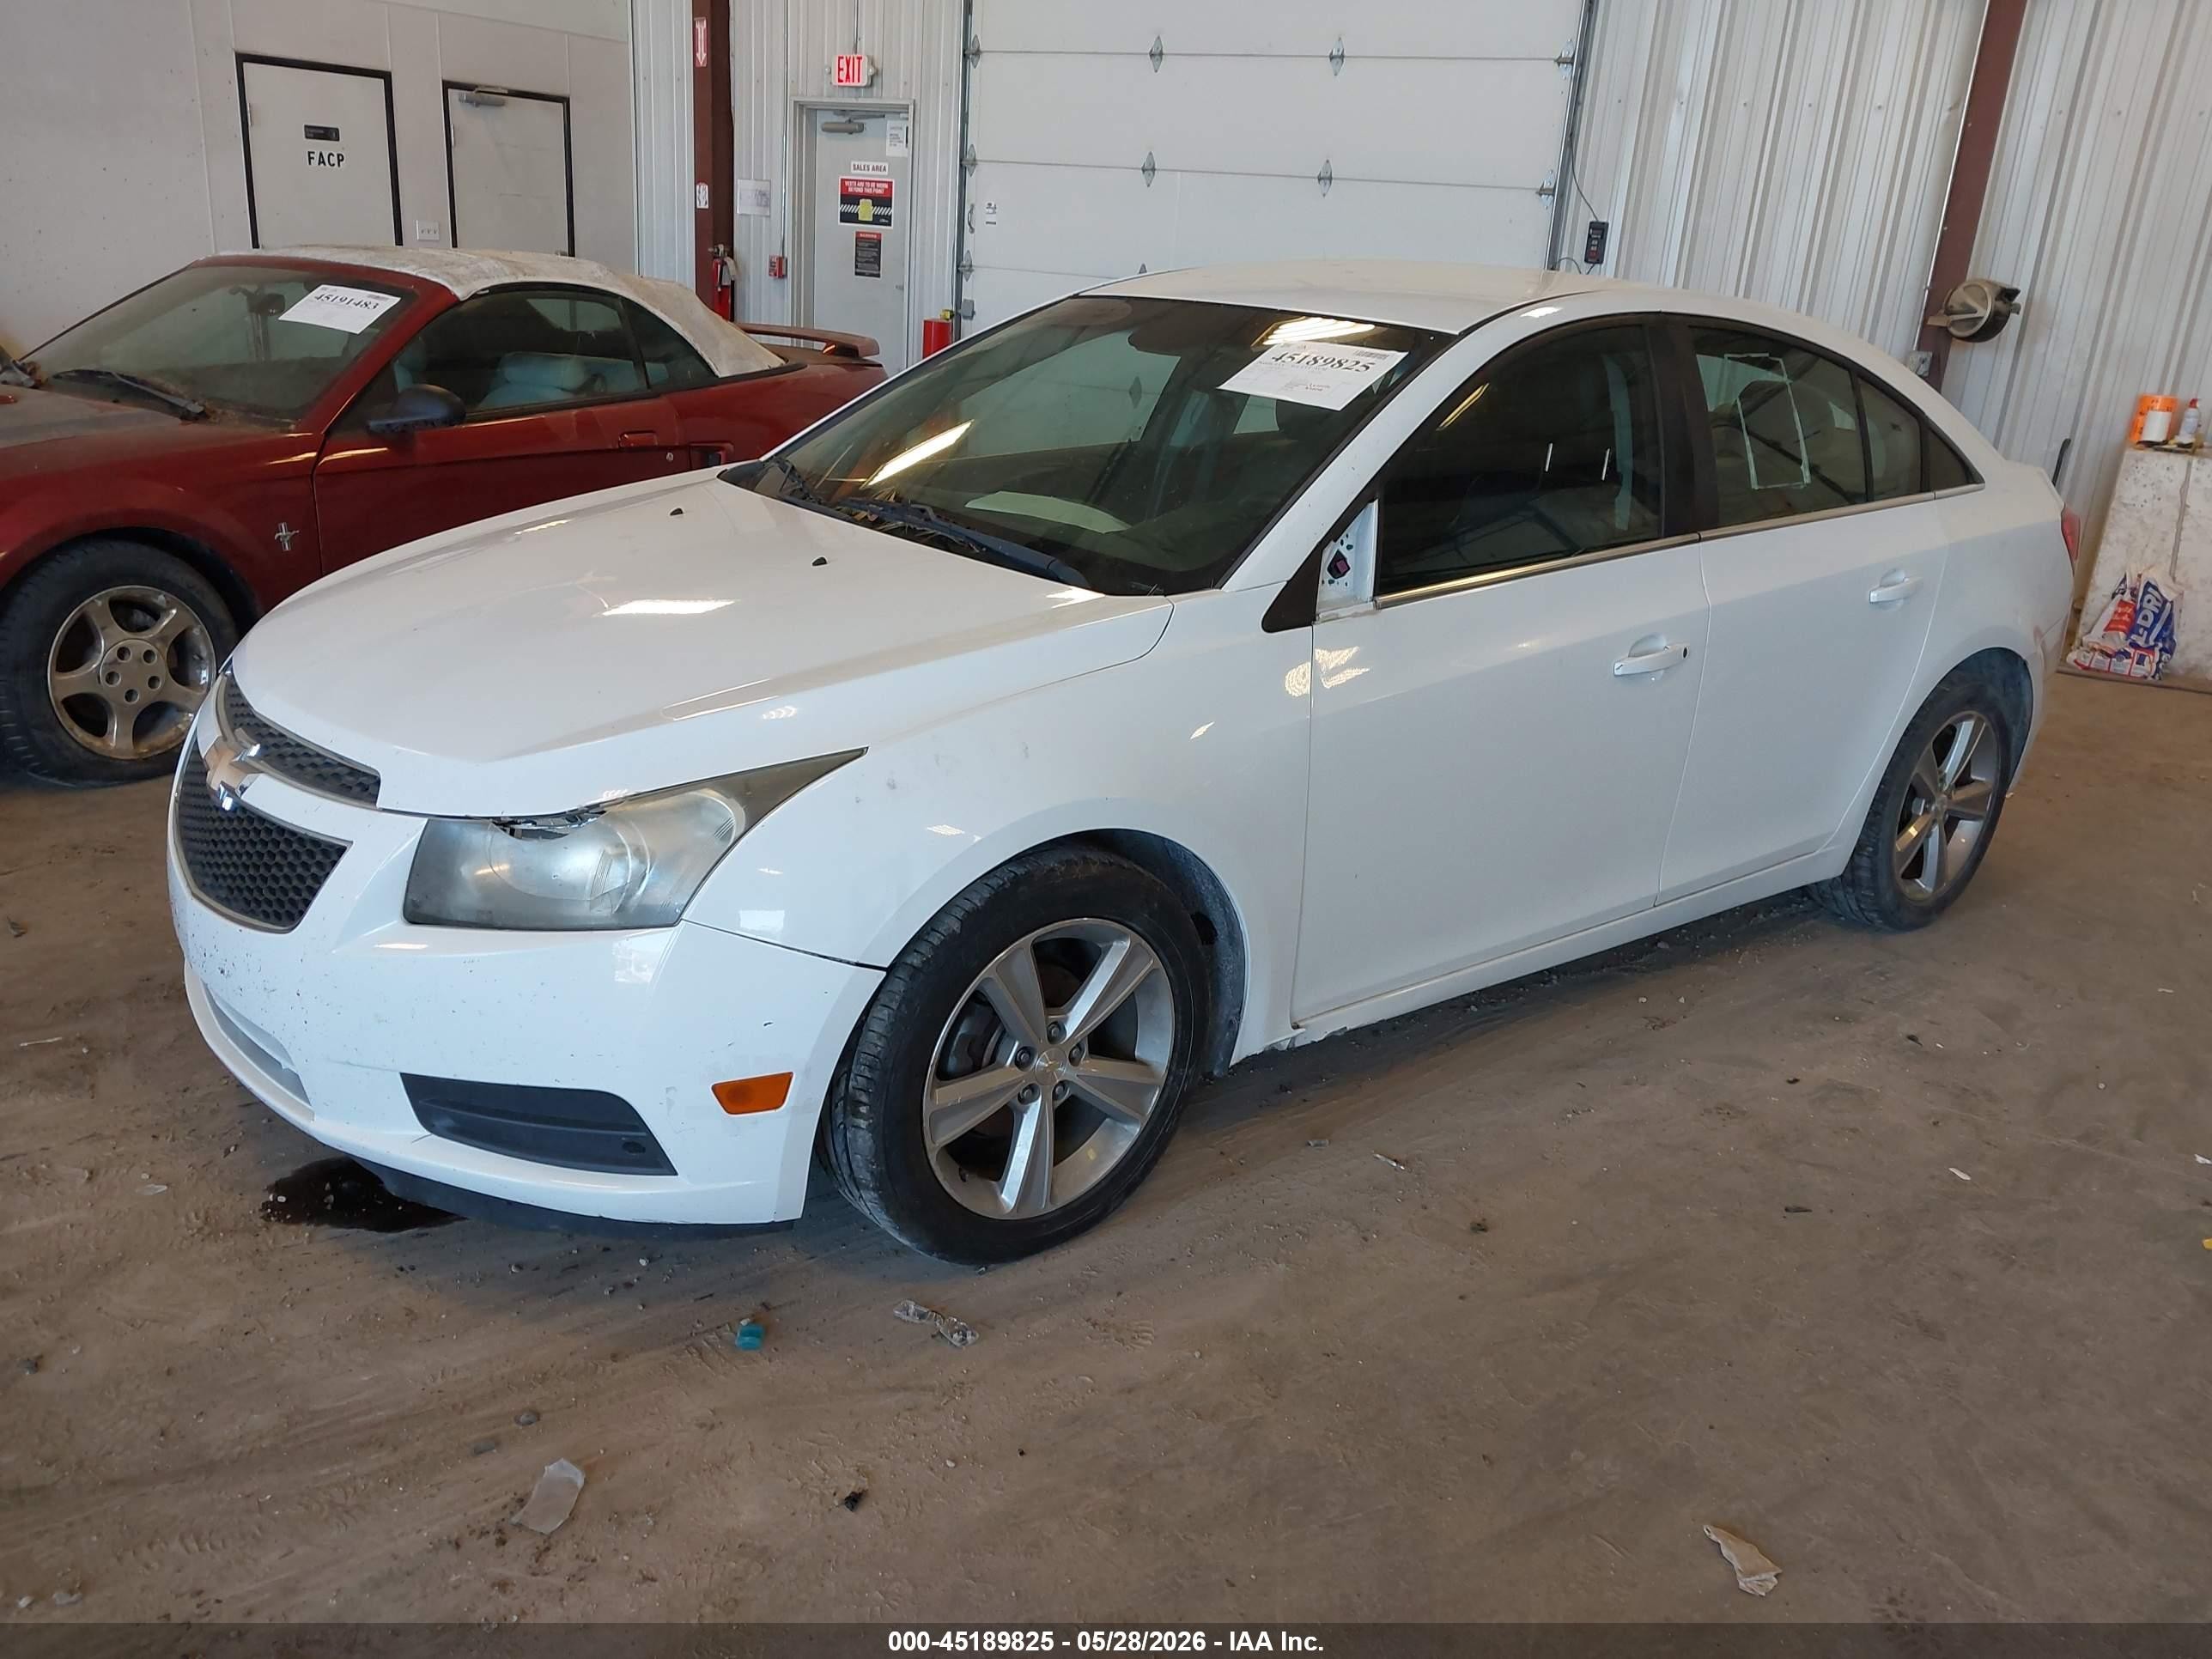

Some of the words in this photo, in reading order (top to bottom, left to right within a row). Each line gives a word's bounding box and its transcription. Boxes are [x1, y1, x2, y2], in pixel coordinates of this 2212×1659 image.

[837, 55, 862, 83] EXIT
[307, 150, 344, 167] FACP
[853, 163, 870, 172] SALES
[871, 164, 887, 173] AREA
[314, 293, 380, 310] 45191483
[1271, 351, 1376, 373] 45189825
